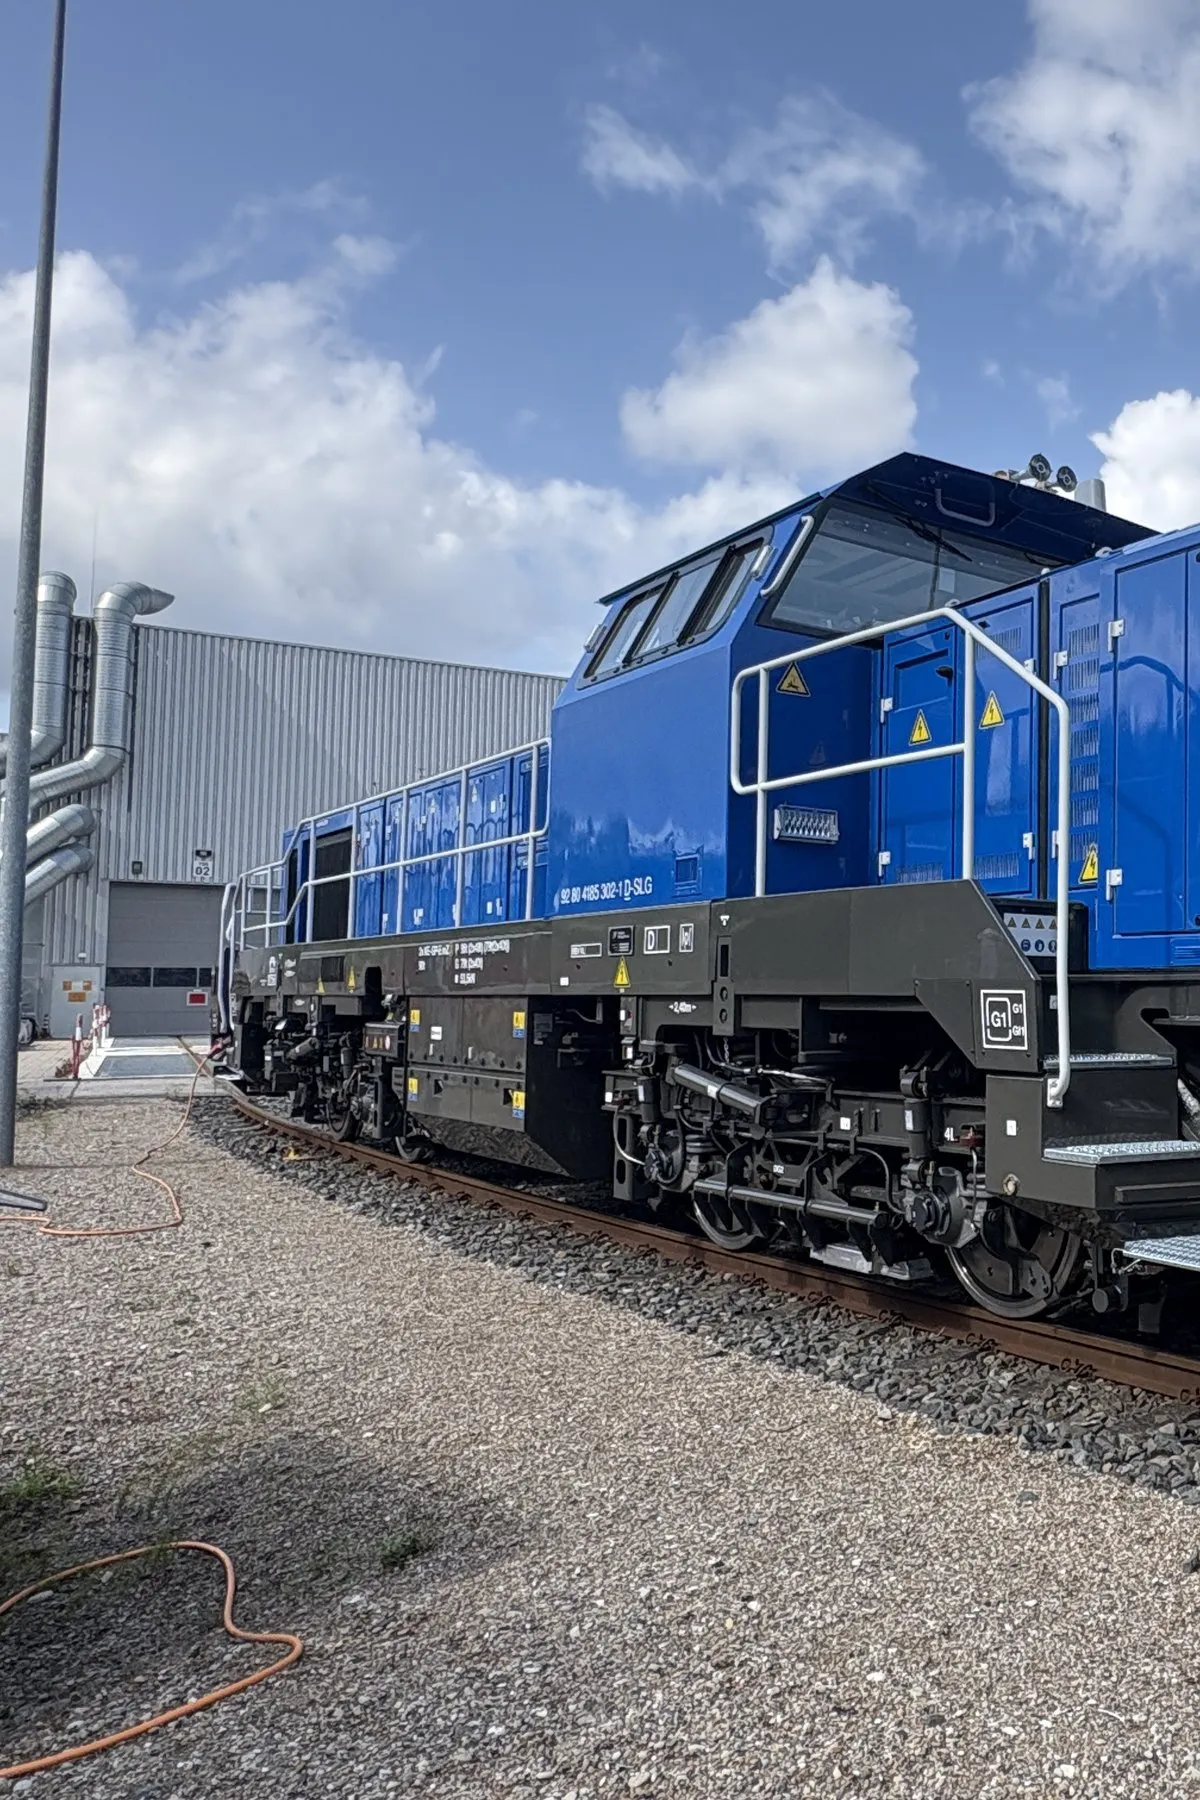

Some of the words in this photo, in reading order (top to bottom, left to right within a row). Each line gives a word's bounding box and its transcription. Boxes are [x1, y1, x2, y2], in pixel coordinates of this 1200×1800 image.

[195, 866, 210, 876] 02
[561, 888, 570, 904] 92
[570, 887, 580, 904] 80
[582, 885, 600, 901] 4185
[601, 882, 623, 899] 302-1
[624, 876, 653, 901] D-SLG
[647, 930, 655, 950] D
[1012, 1003, 1023, 1014] G1
[991, 1011, 1007, 1028] G1
[944, 1127, 958, 1141] 4L
